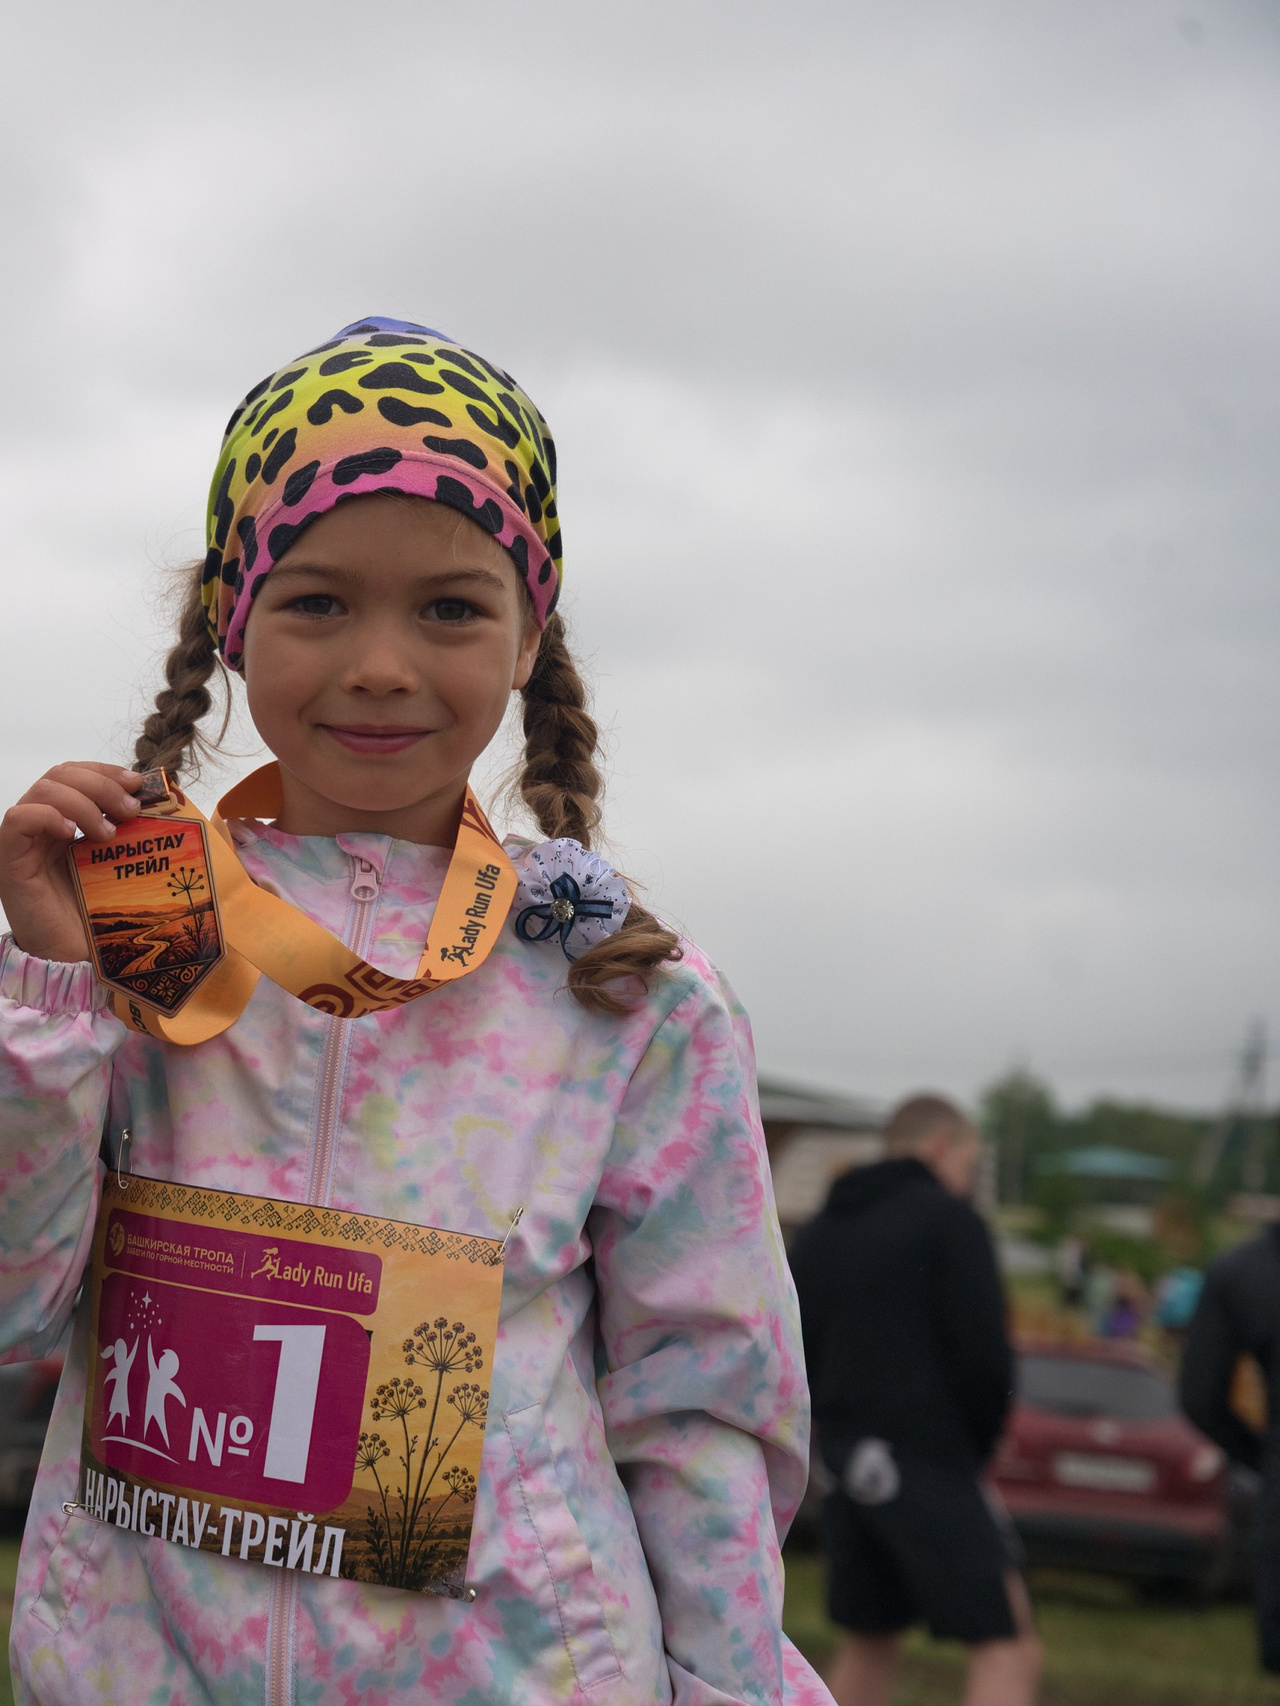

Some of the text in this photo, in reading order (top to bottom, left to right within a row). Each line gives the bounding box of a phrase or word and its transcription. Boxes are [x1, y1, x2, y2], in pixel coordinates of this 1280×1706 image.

[91, 833, 185, 864] НАРЫСТАУ
[114, 855, 169, 880] ТРЕЙЛ
[456, 864, 501, 950] Lady Run Ufa
[126, 1246, 234, 1275] ЗАБЕГИ ПО ГОРНОЙ МЕСТНОСТИ
[127, 1234, 234, 1264] БАШКИРСКАЯ ТРОПА
[275, 1260, 373, 1294] Lady Run Ufa
[85, 1467, 347, 1578] НАРЫСТАУ-ТРЕЙЛ
